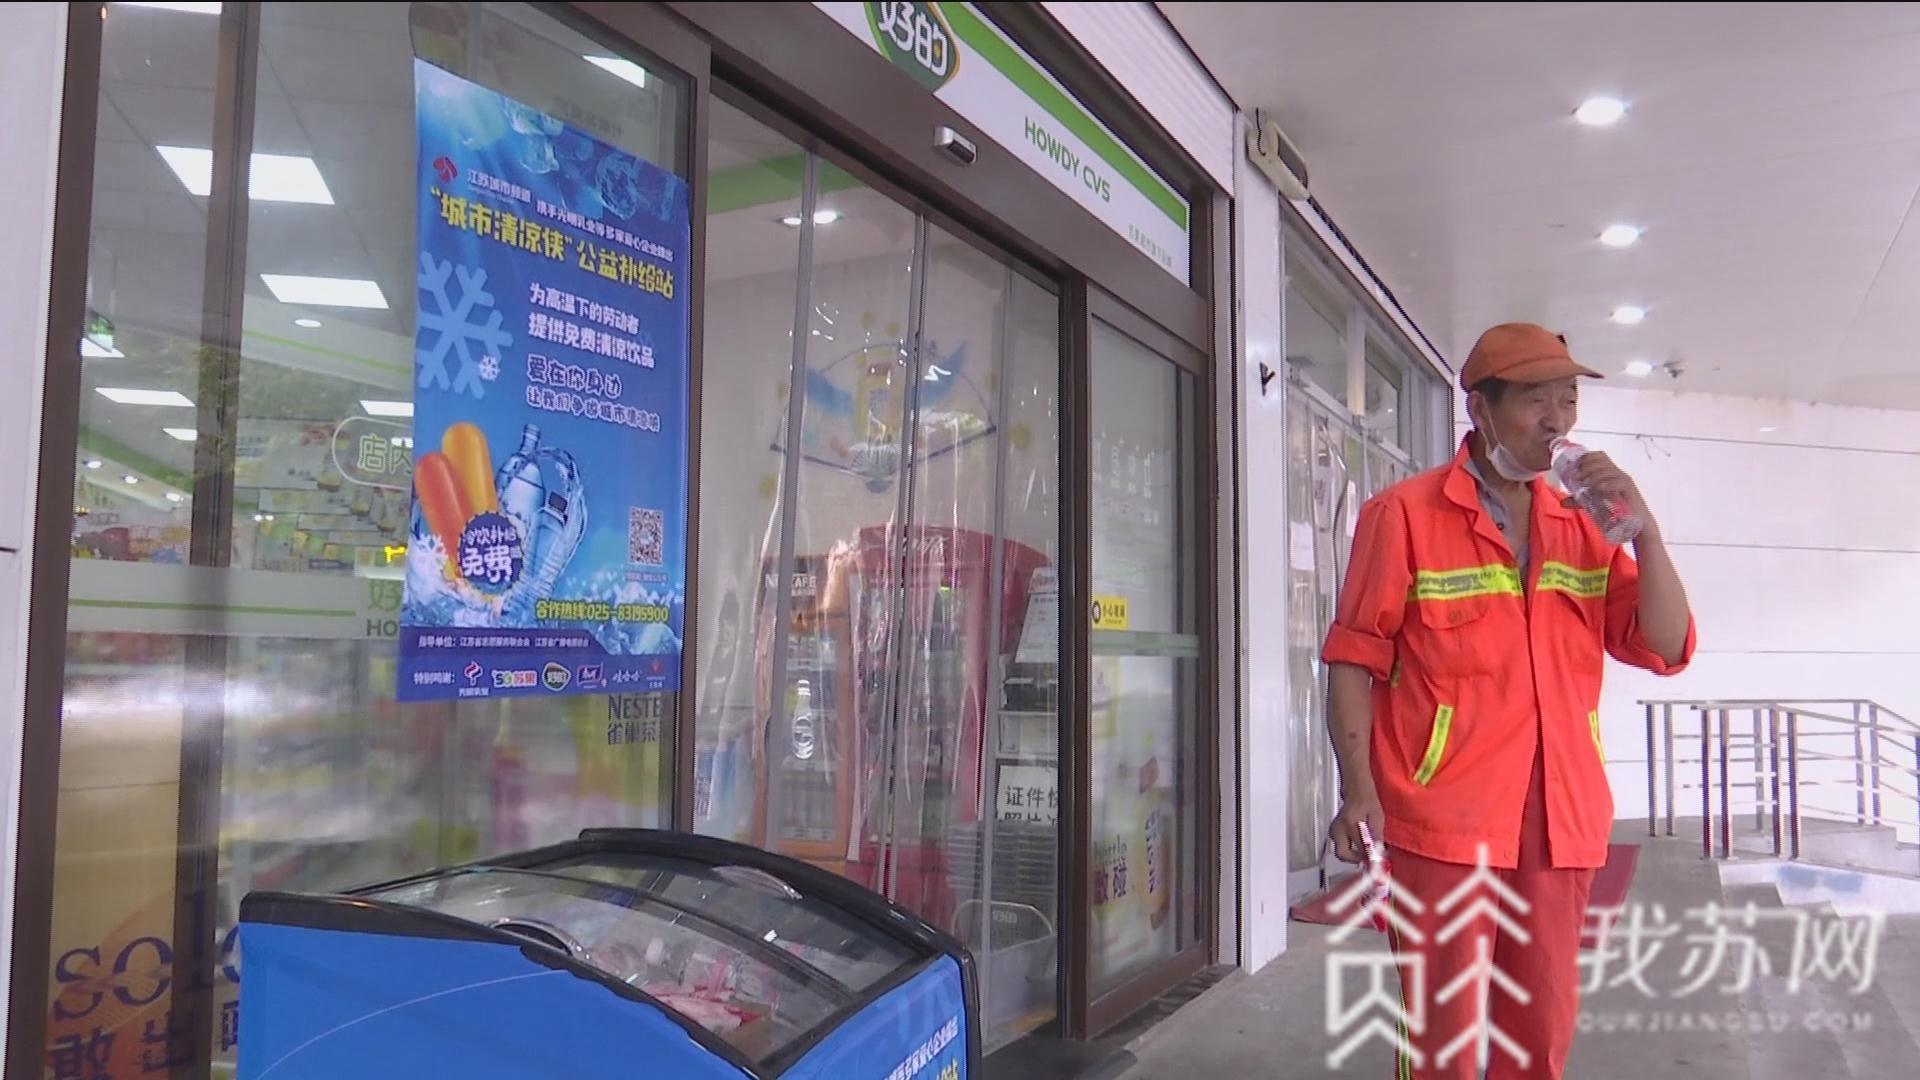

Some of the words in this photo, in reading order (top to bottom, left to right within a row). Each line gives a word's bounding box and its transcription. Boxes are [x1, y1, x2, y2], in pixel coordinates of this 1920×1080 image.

[1024, 115, 1080, 177] HOWDY
[1083, 165, 1111, 203] CVS
[529, 281, 641, 335] 为高温下的劳动者
[528, 311, 656, 369] 提供免费清凉饮品
